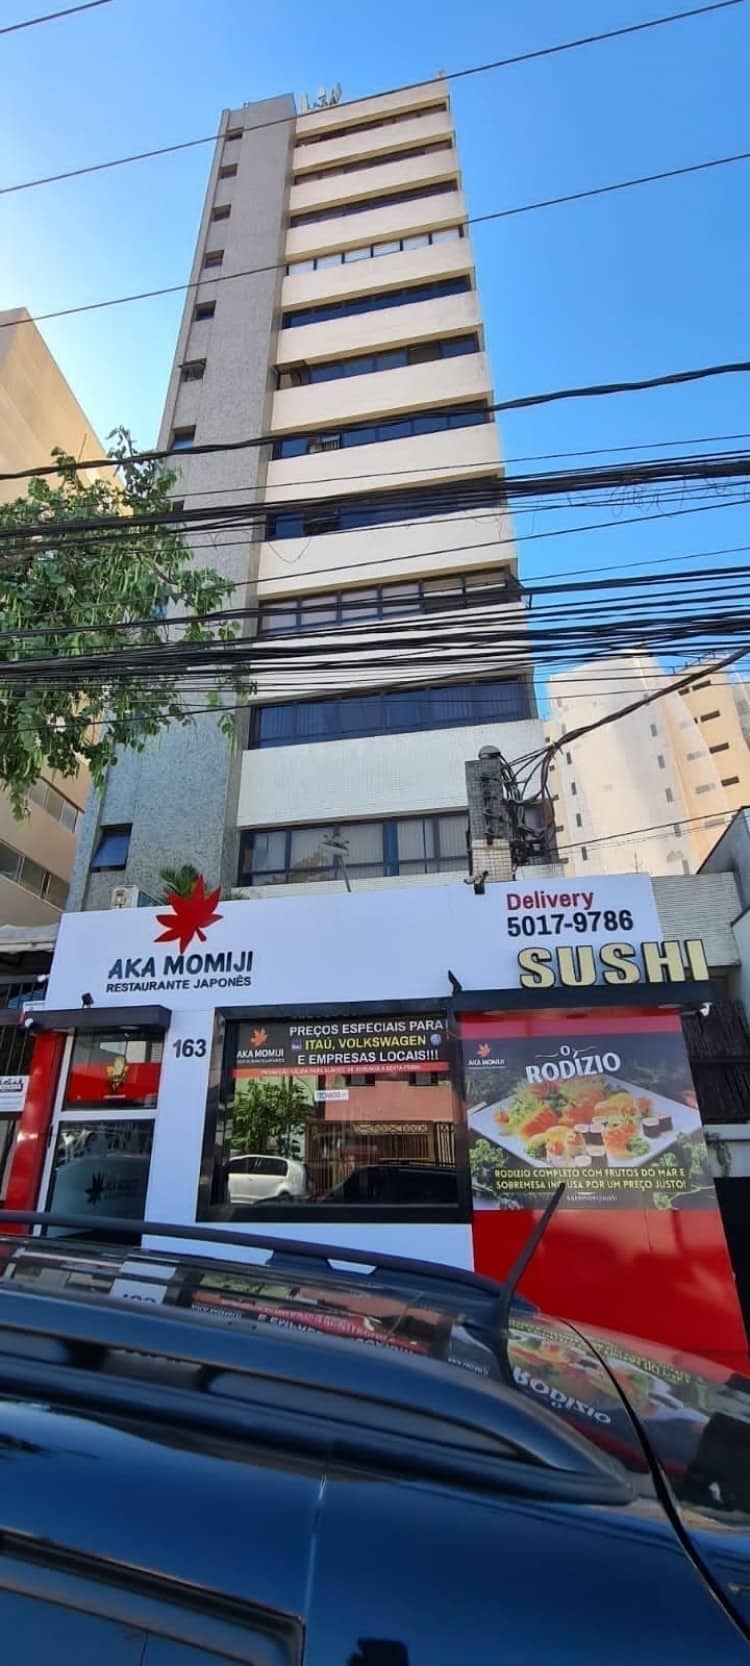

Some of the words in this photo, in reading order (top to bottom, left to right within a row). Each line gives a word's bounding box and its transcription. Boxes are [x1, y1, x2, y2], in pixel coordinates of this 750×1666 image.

[506, 890, 594, 911] Delivery
[507, 910, 634, 937] 5017-9786
[108, 957, 156, 979] AKA
[163, 950, 253, 976] MOMIJI
[517, 938, 710, 989] SUSHI
[106, 979, 190, 993] RESTAURANTE
[193, 975, 252, 989] JAPONÊS
[289, 1024, 338, 1038] PREÇOS
[342, 1021, 406, 1034] ESPECIAIS
[409, 1019, 443, 1031] PARA
[172, 1039, 207, 1058] 163
[305, 1037, 335, 1051] ITAÚ,
[339, 1035, 426, 1048] VOLKSWAGEN
[560, 1045, 571, 1056] O
[236, 1049, 254, 1058] AKA
[255, 1048, 284, 1058] MOMIJI
[297, 1055, 304, 1065] E
[308, 1051, 376, 1065] EMPRESAS
[379, 1049, 439, 1062] LOCAIS!!!
[525, 1051, 622, 1084] RODÍZIO
[532, 1168, 579, 1178] COMPLETO
[582, 1168, 603, 1178] COM
[604, 1168, 639, 1178] FRUTOS
[641, 1168, 656, 1177] DO
[658, 1168, 678, 1177] MAR
[680, 1168, 685, 1177] E
[496, 1180, 545, 1190] SOBREMESA
[585, 1180, 605, 1189] POR
[607, 1180, 622, 1189] UM
[623, 1180, 653, 1191] PREÇO
[655, 1179, 687, 1189] JUSTO!
